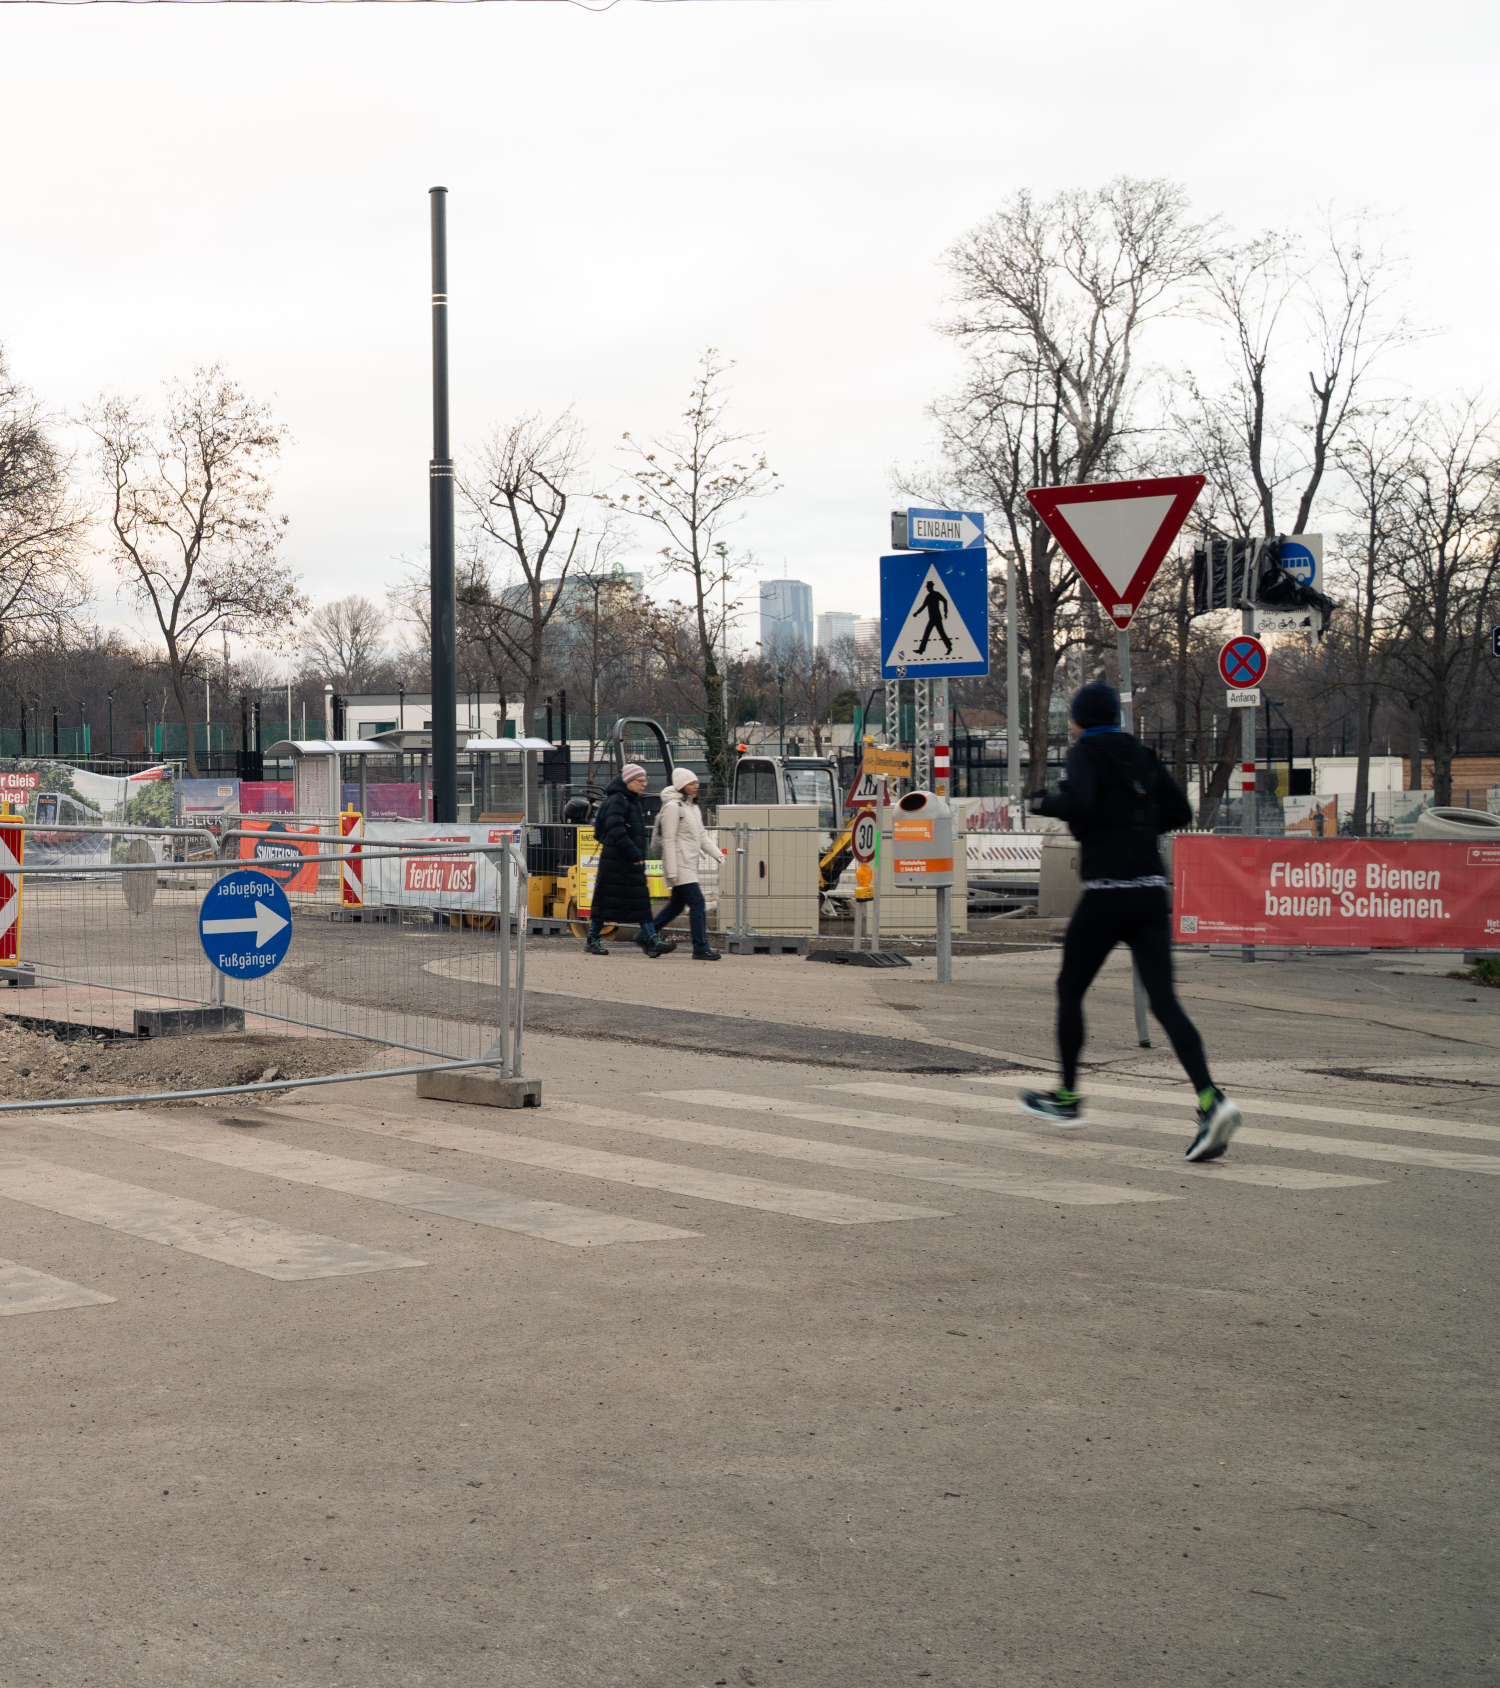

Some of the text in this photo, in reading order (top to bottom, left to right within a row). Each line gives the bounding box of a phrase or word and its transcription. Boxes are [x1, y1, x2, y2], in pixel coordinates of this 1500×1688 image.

[917, 520, 961, 539] EINBAHN
[876, 756, 902, 770] Umleitung
[8, 774, 36, 788] Gleis
[858, 824, 874, 850] 30
[409, 862, 472, 894] fertig los!
[1269, 862, 1441, 895] Fleißige Bienen
[217, 881, 275, 898] Fußgänger
[1264, 889, 1451, 919] bauen Schienen.
[219, 952, 277, 970] Fußgänger
